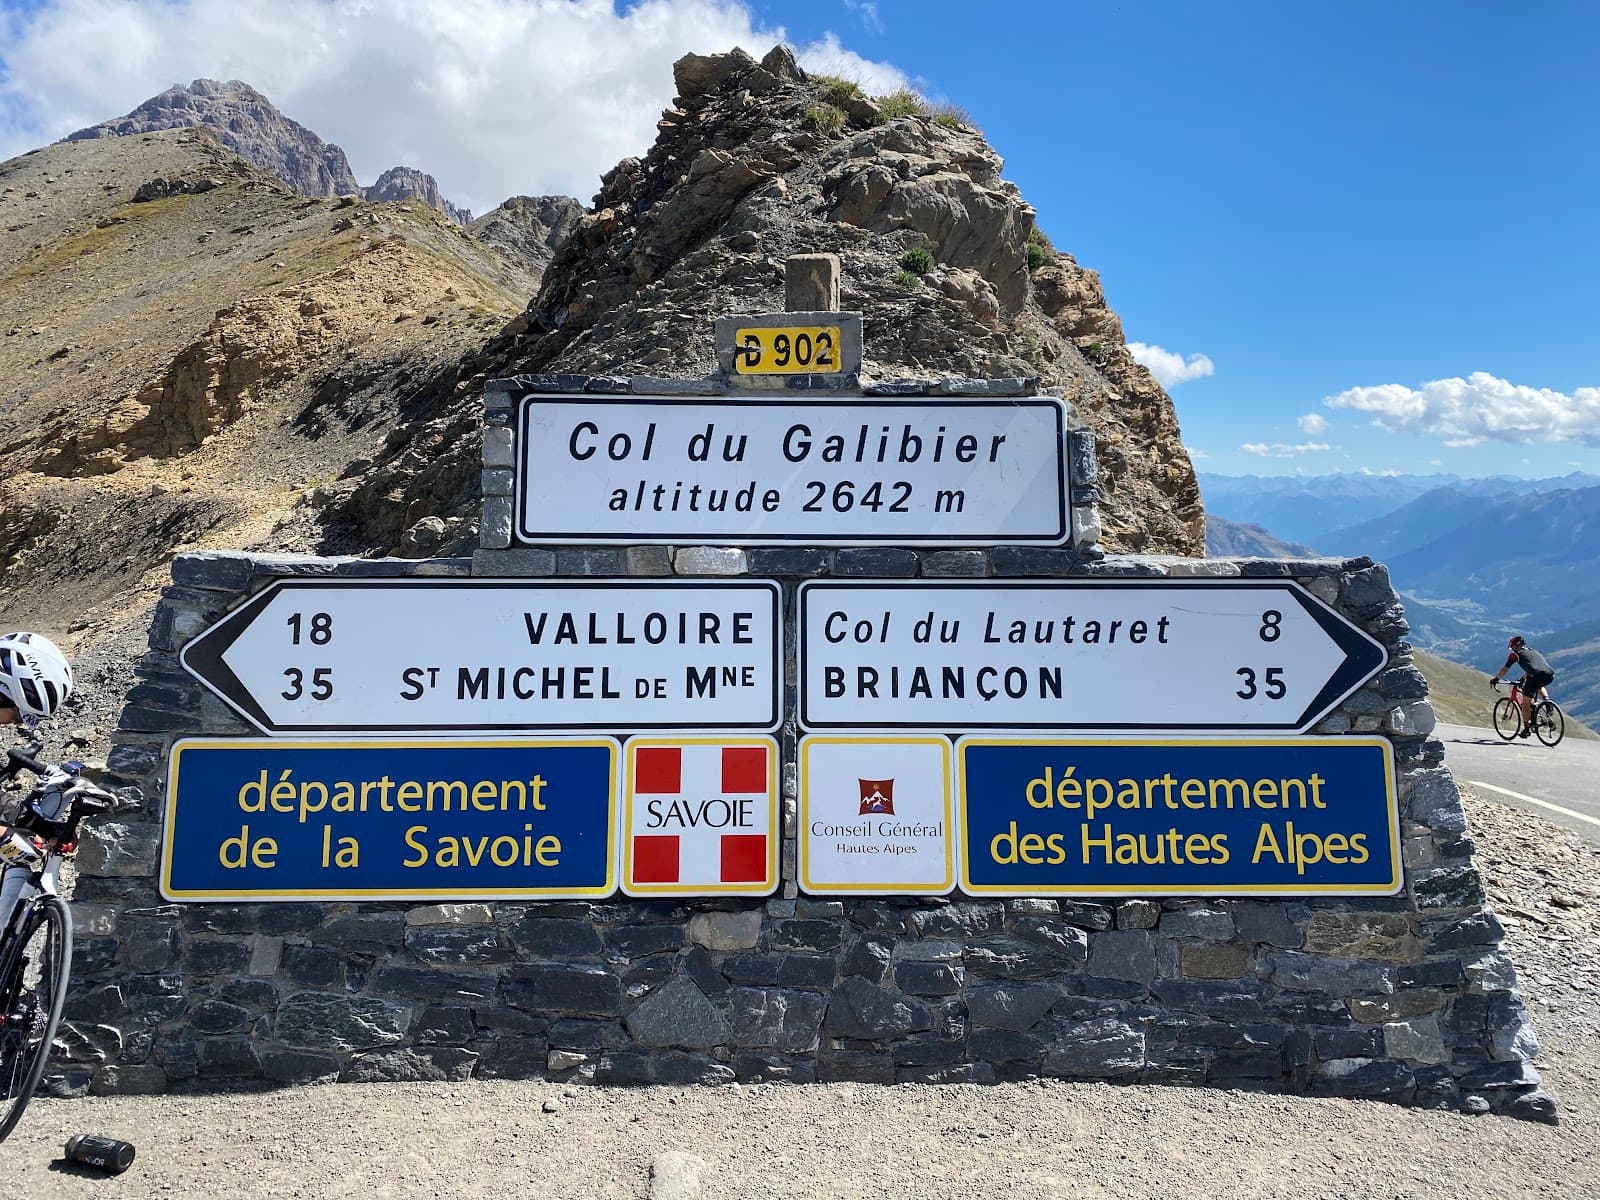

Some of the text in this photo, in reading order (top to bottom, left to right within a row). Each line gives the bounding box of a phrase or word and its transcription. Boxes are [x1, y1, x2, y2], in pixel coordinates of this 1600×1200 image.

[744, 333, 833, 367] D 902
[569, 421, 1007, 464] Col du Galibier
[608, 479, 965, 513] altitude 2642 m
[287, 612, 753, 646] 18 VALLOIRE
[824, 610, 1282, 644] Col du Lautaret 8
[280, 667, 334, 701] 35
[457, 666, 621, 700] MICHEL
[635, 678, 667, 699] DE
[824, 666, 1287, 702] BRIANÇON 35
[238, 769, 547, 823] département
[1025, 766, 1326, 819] département
[646, 799, 754, 828] SAVOIE
[811, 820, 942, 837] Conseil Général
[218, 823, 561, 868] de la Savoie
[836, 843, 918, 855] Hautes Alpes
[990, 821, 1369, 874] des Hautes Alpes
